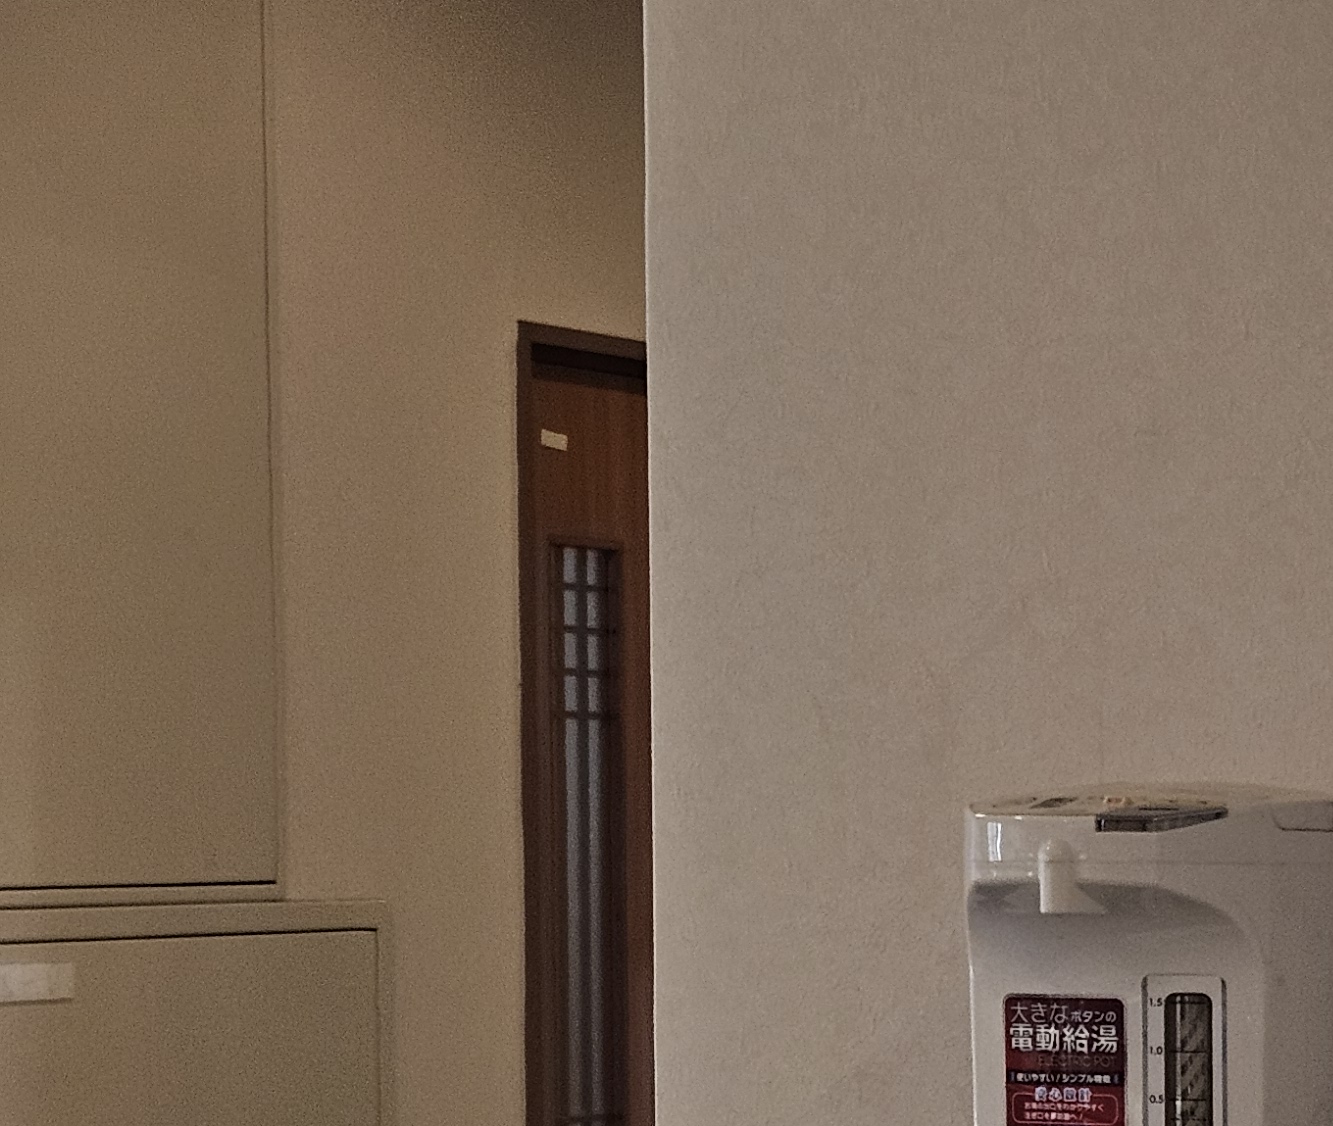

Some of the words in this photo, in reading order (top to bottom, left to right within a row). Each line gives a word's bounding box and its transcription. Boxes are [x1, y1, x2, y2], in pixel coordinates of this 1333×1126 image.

[1011, 1002, 1116, 1023] 大きなボタンの
[1010, 1024, 1118, 1053] 電動給湯
[1149, 1094, 1164, 1104] 0.5
